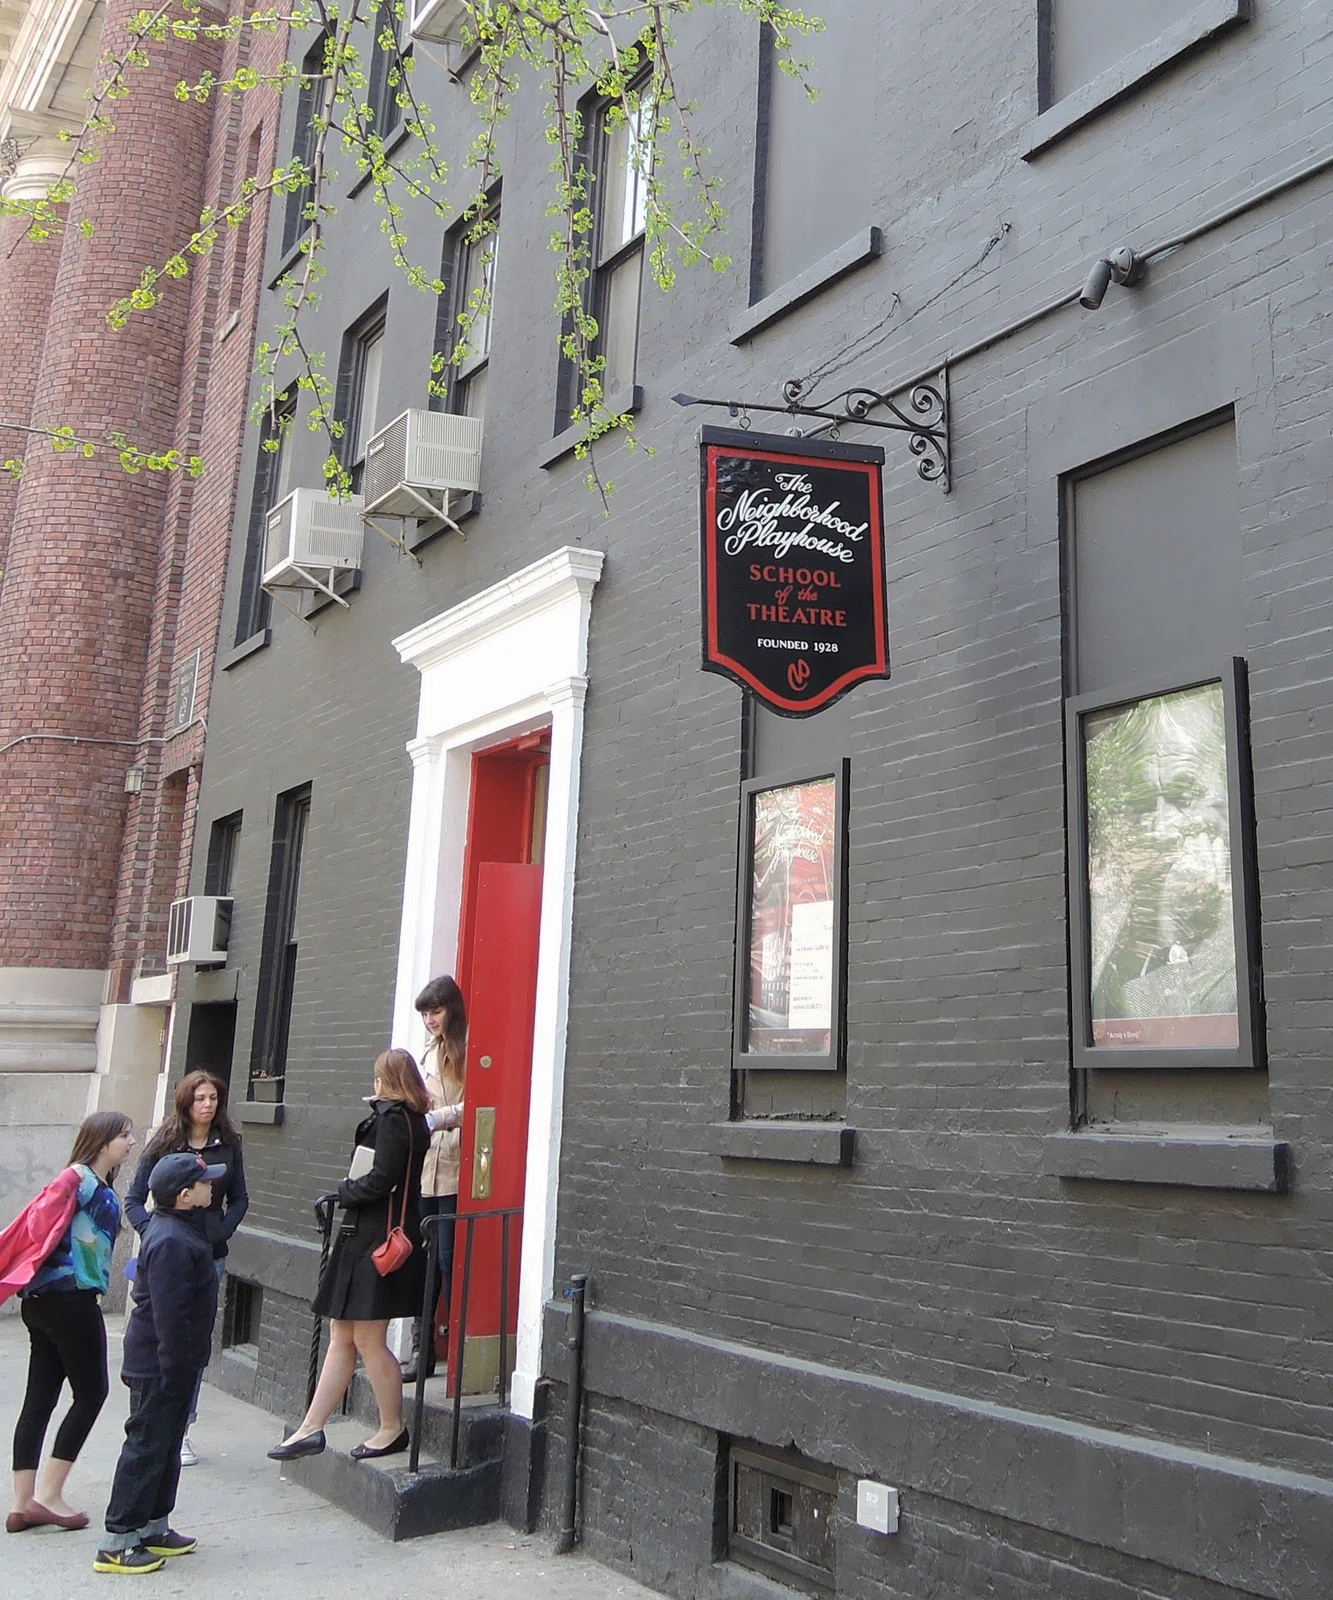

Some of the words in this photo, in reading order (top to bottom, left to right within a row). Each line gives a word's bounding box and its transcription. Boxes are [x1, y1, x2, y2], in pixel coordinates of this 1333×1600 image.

[775, 473, 813, 493] The
[717, 488, 868, 541] Neighborhood
[725, 519, 854, 563] Playhouse
[749, 564, 841, 588] SCHOOL
[774, 585, 793, 605] of
[797, 585, 818, 602] the
[747, 603, 847, 627] THEATRE
[757, 638, 809, 651] FOUNDED
[813, 642, 839, 653] 1928
